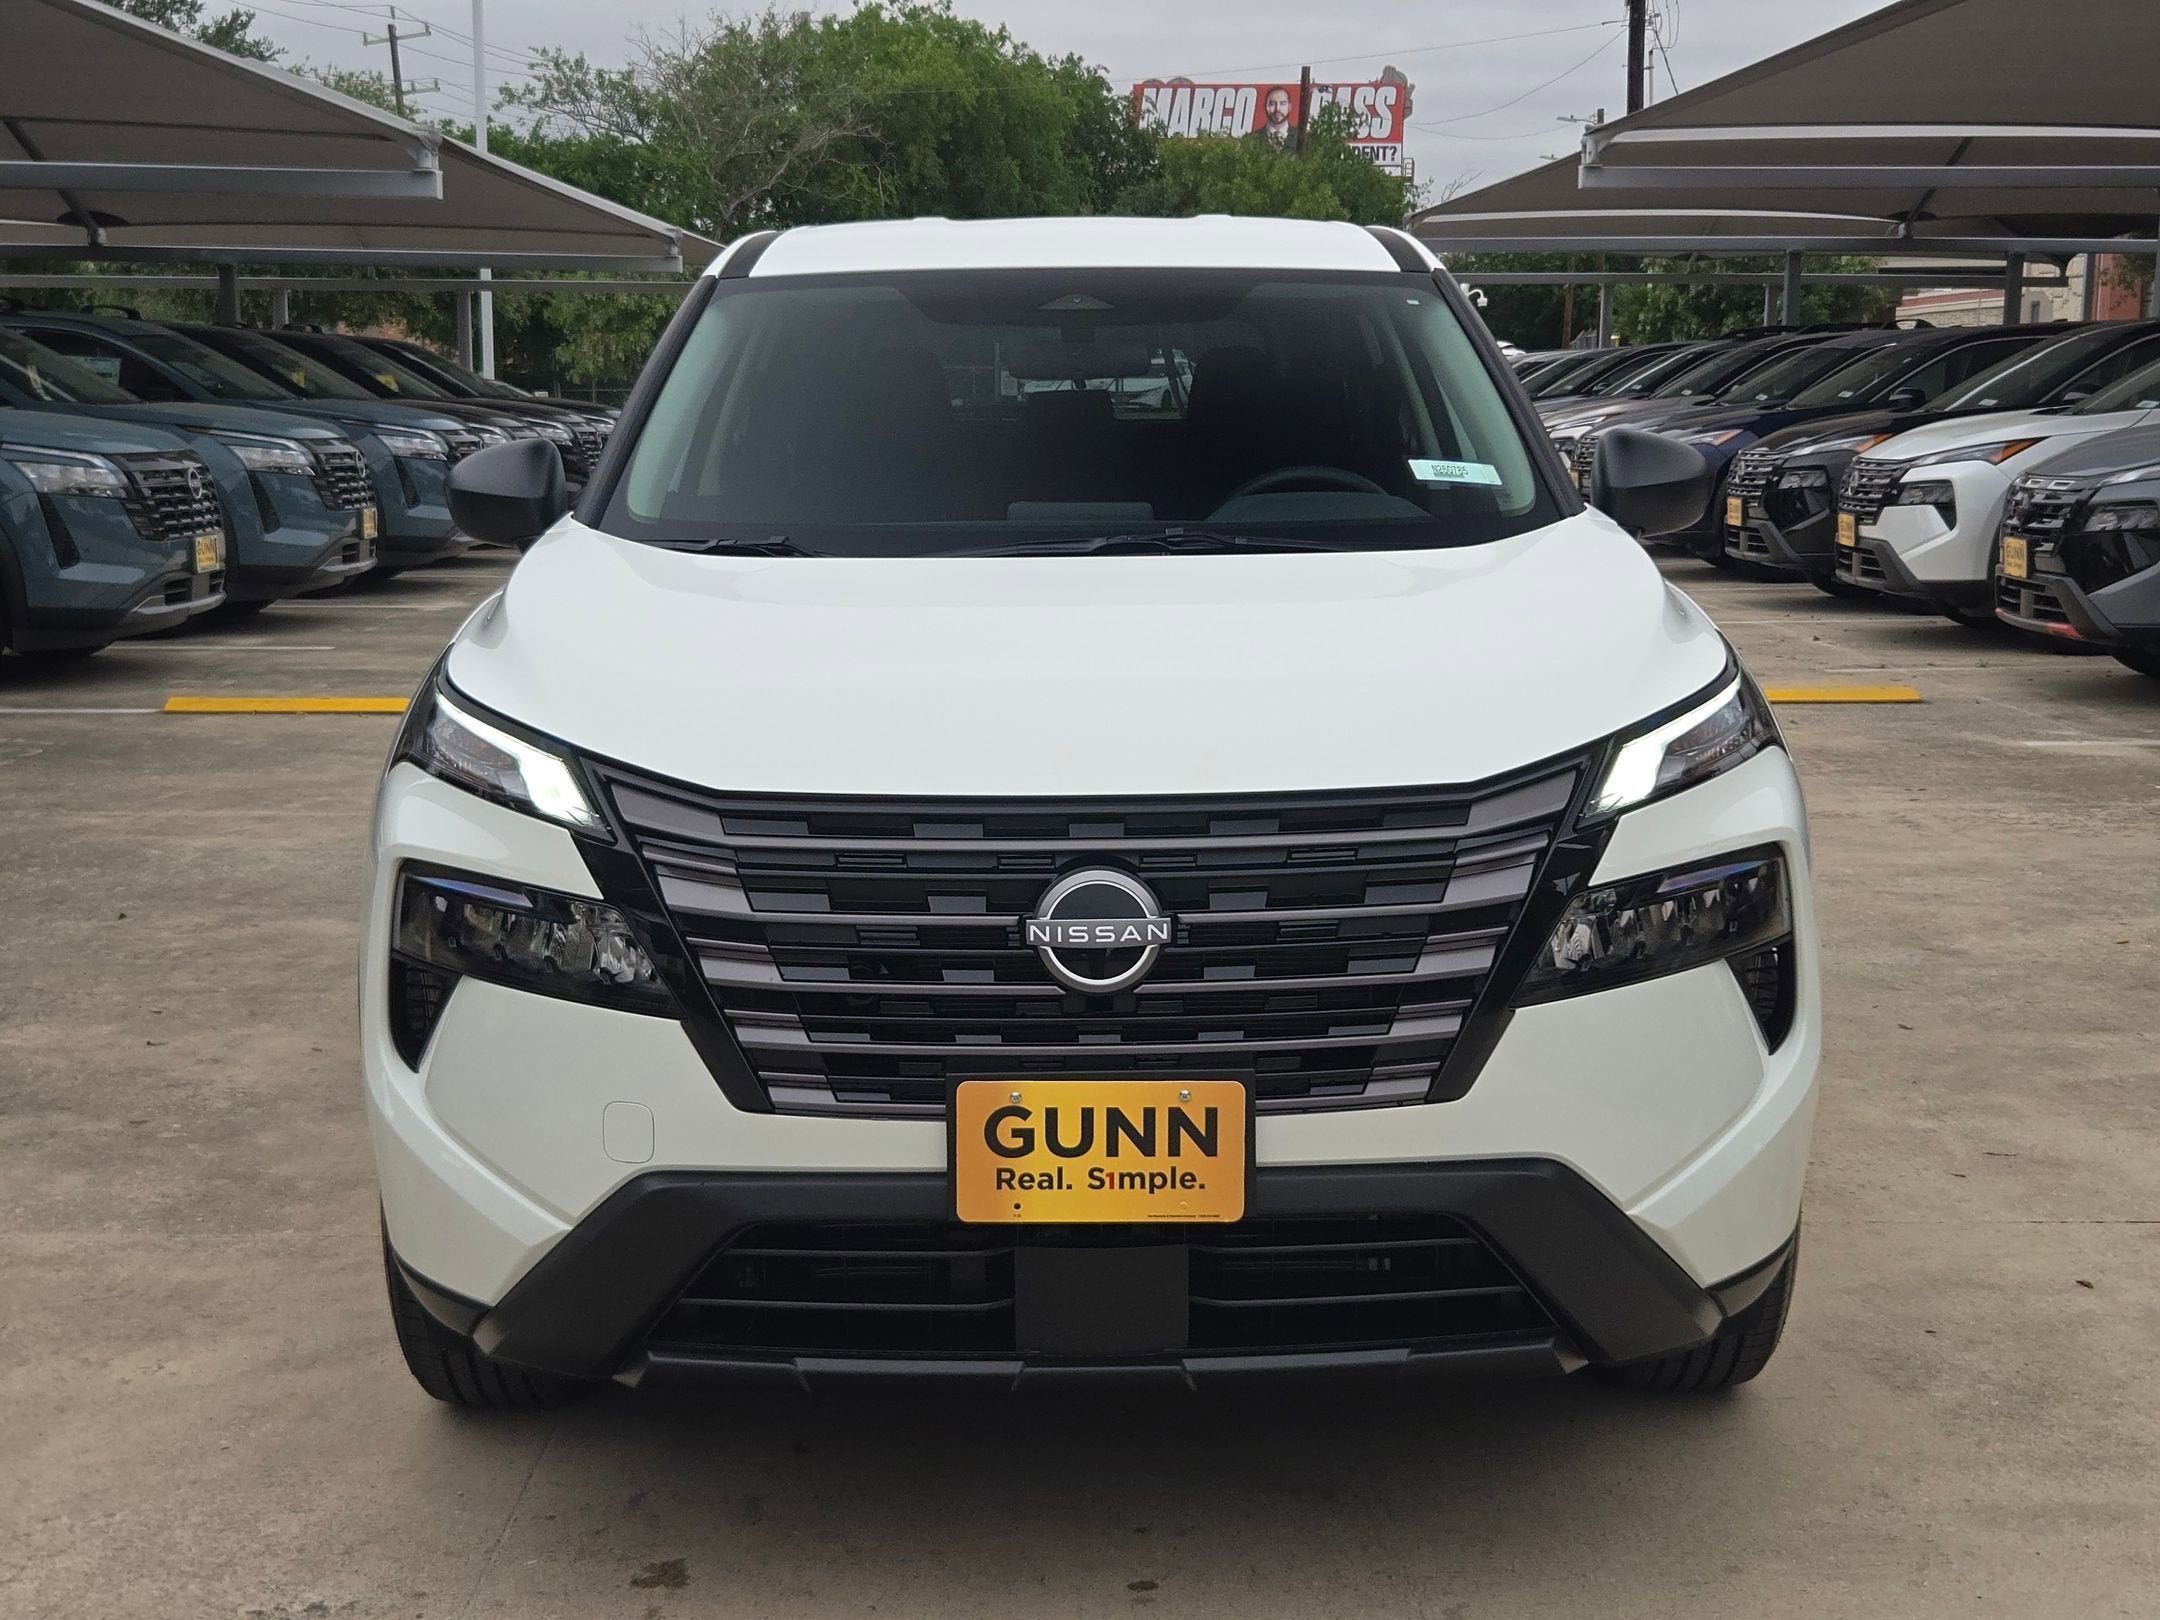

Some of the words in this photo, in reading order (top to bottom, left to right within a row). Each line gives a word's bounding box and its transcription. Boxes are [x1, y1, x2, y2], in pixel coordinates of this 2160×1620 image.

[1138, 87, 1257, 138] MARCO
[1029, 923, 1168, 943] NISSAN
[984, 1105, 1218, 1158] GUNN
[996, 1166, 1073, 1190] Real.
